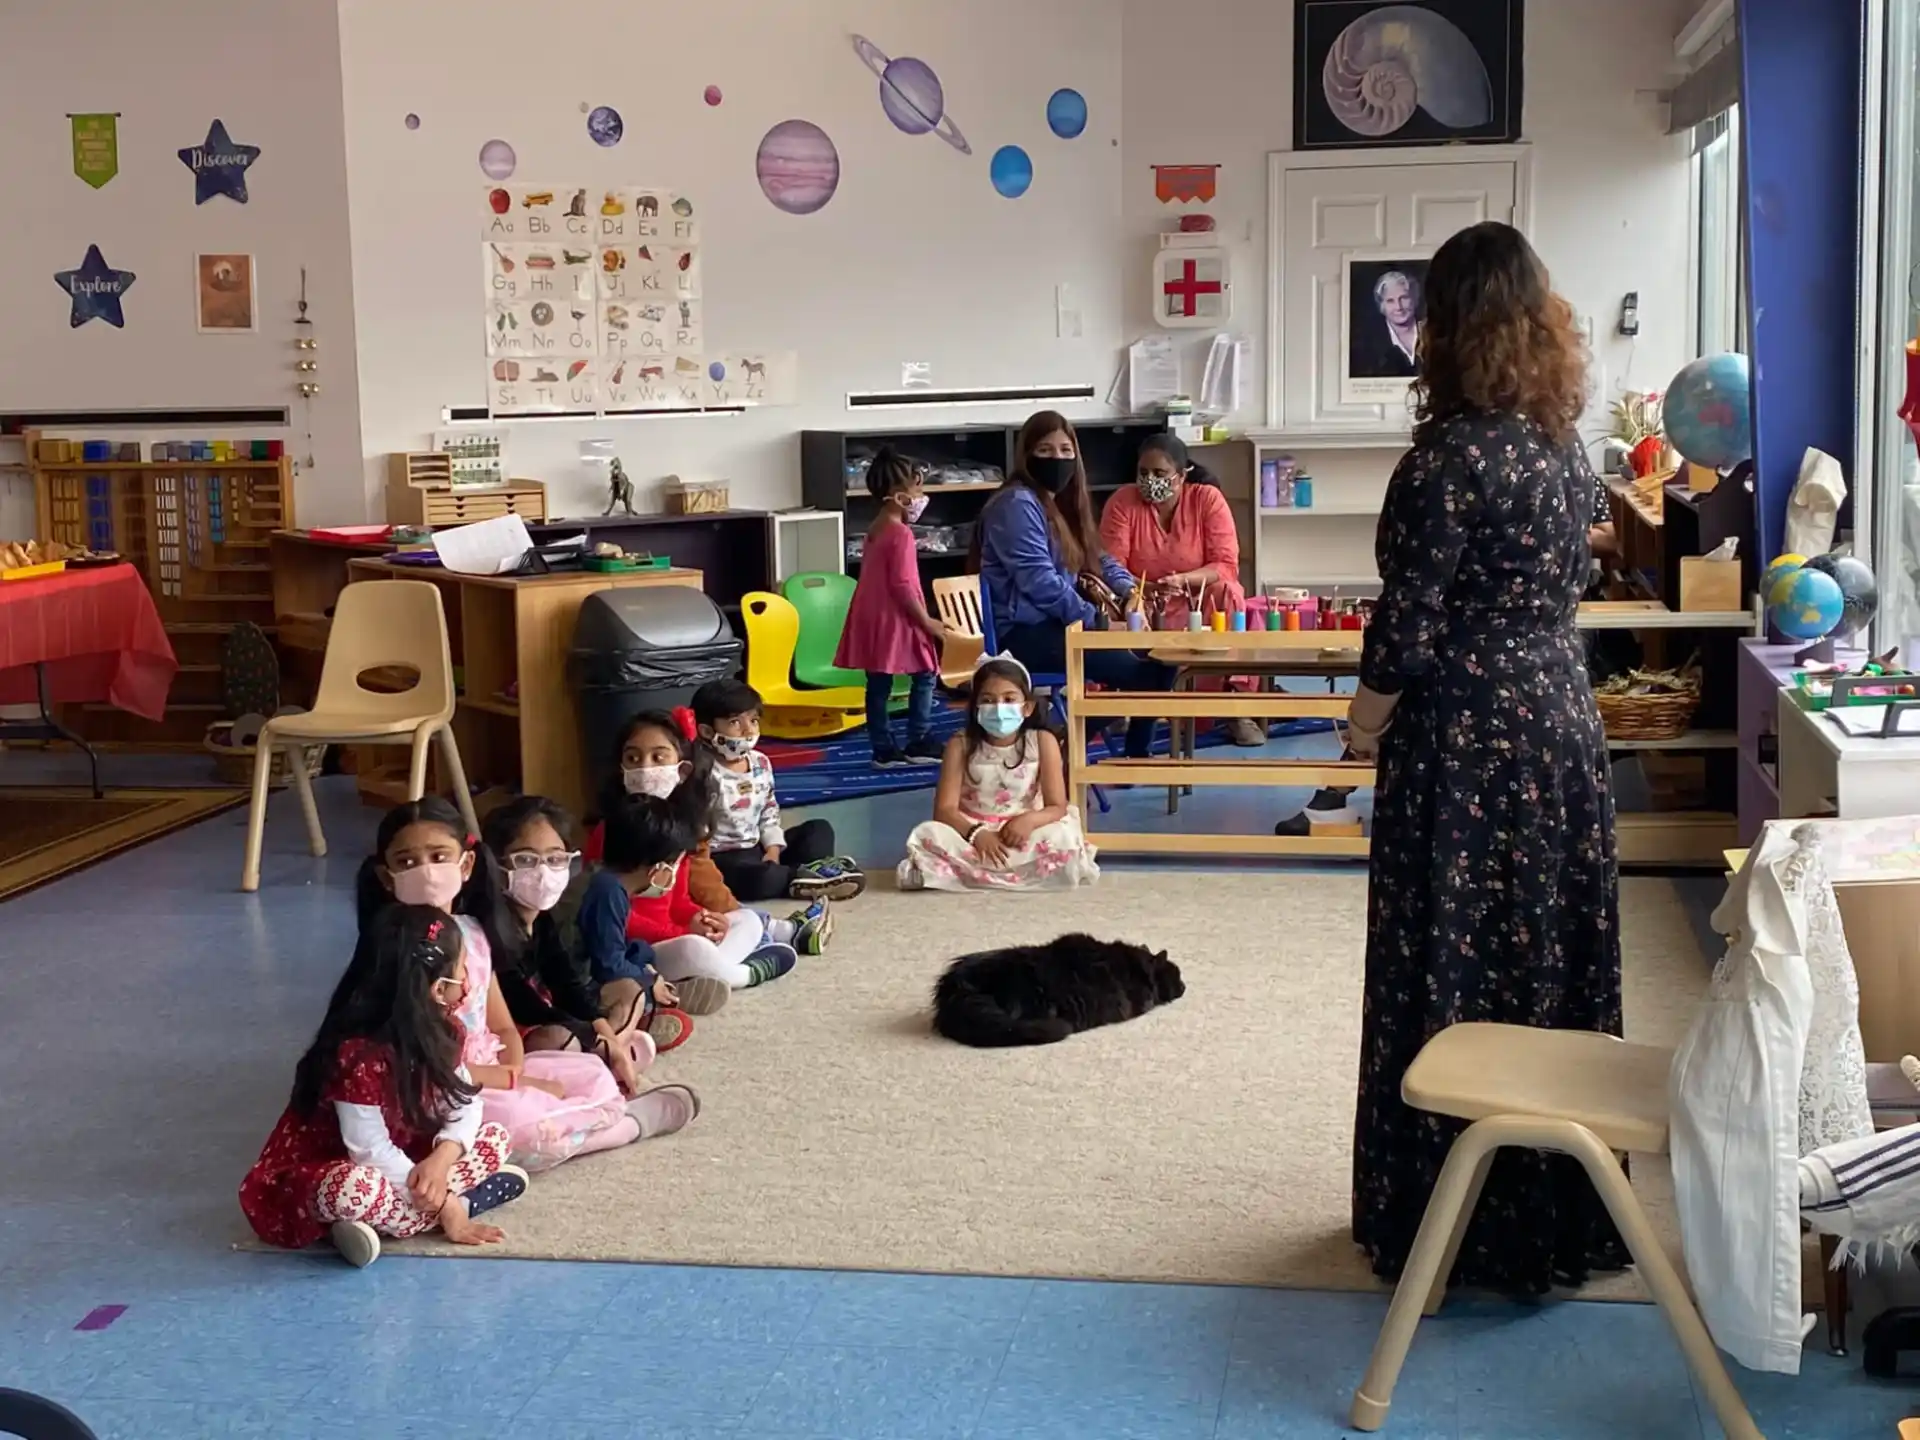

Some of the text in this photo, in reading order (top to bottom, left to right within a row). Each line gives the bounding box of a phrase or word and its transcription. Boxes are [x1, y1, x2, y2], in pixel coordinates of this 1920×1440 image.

[192, 149, 248, 169] Discover
[529, 217, 550, 233] Bb
[566, 217, 587, 233] Cc
[602, 218, 623, 234] Dd
[70, 274, 121, 298] Explore
[492, 273, 515, 296] Gg
[531, 275, 553, 290] Hh
[533, 332, 554, 348] Nn
[569, 332, 591, 348] Oo
